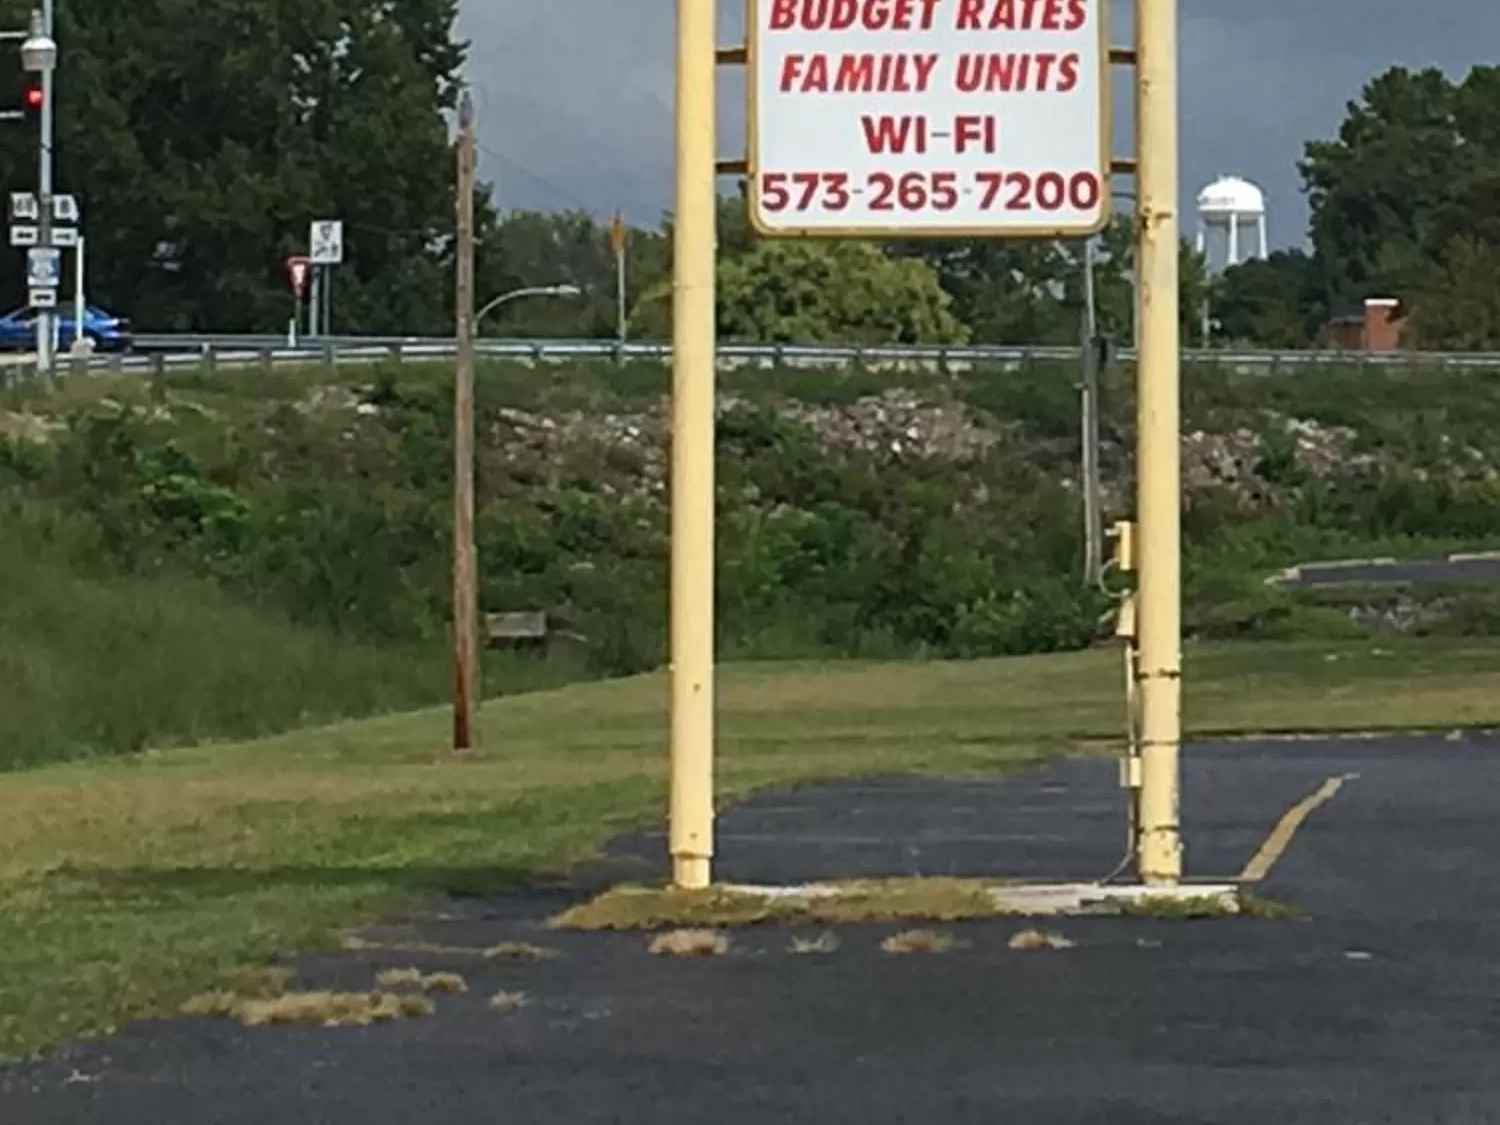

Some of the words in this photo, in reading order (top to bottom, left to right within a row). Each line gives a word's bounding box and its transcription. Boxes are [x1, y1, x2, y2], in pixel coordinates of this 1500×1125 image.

[779, 53, 940, 93] FAMILY
[955, 53, 1080, 93] UNITS
[861, 115, 997, 155] WI-FI
[761, 172, 1101, 212] 573-265-7200
